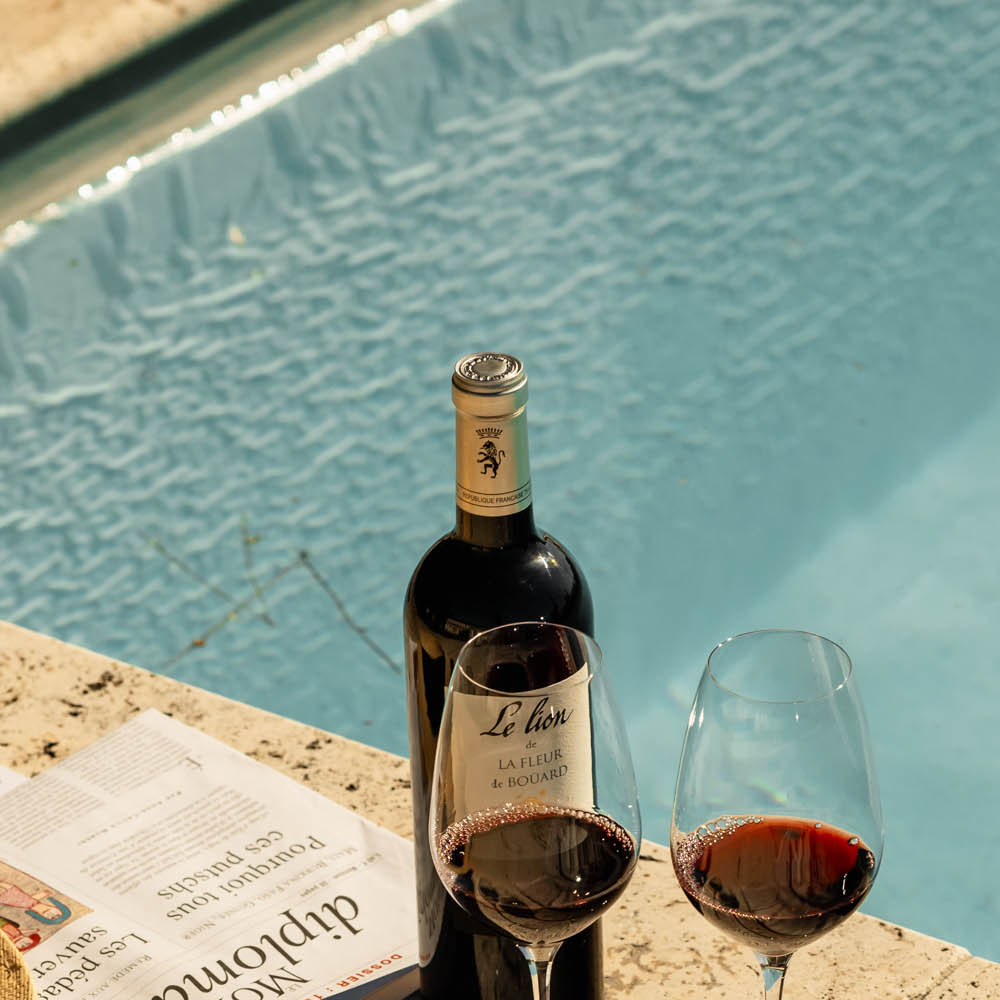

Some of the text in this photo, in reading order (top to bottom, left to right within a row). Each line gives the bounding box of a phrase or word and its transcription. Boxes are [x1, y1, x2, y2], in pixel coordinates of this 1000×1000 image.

[480, 697, 573, 738] Le lion
[499, 749, 564, 770] LA FLEUR
[526, 740, 537, 749] de
[491, 778, 503, 789] de
[157, 831, 283, 901] ces putschs
[218, 835, 325, 896] Pourquoi
[165, 890, 218, 922] tous
[32, 926, 107, 978] sauver
[99, 933, 147, 957] Les
[335, 952, 402, 988] DOSSIER
